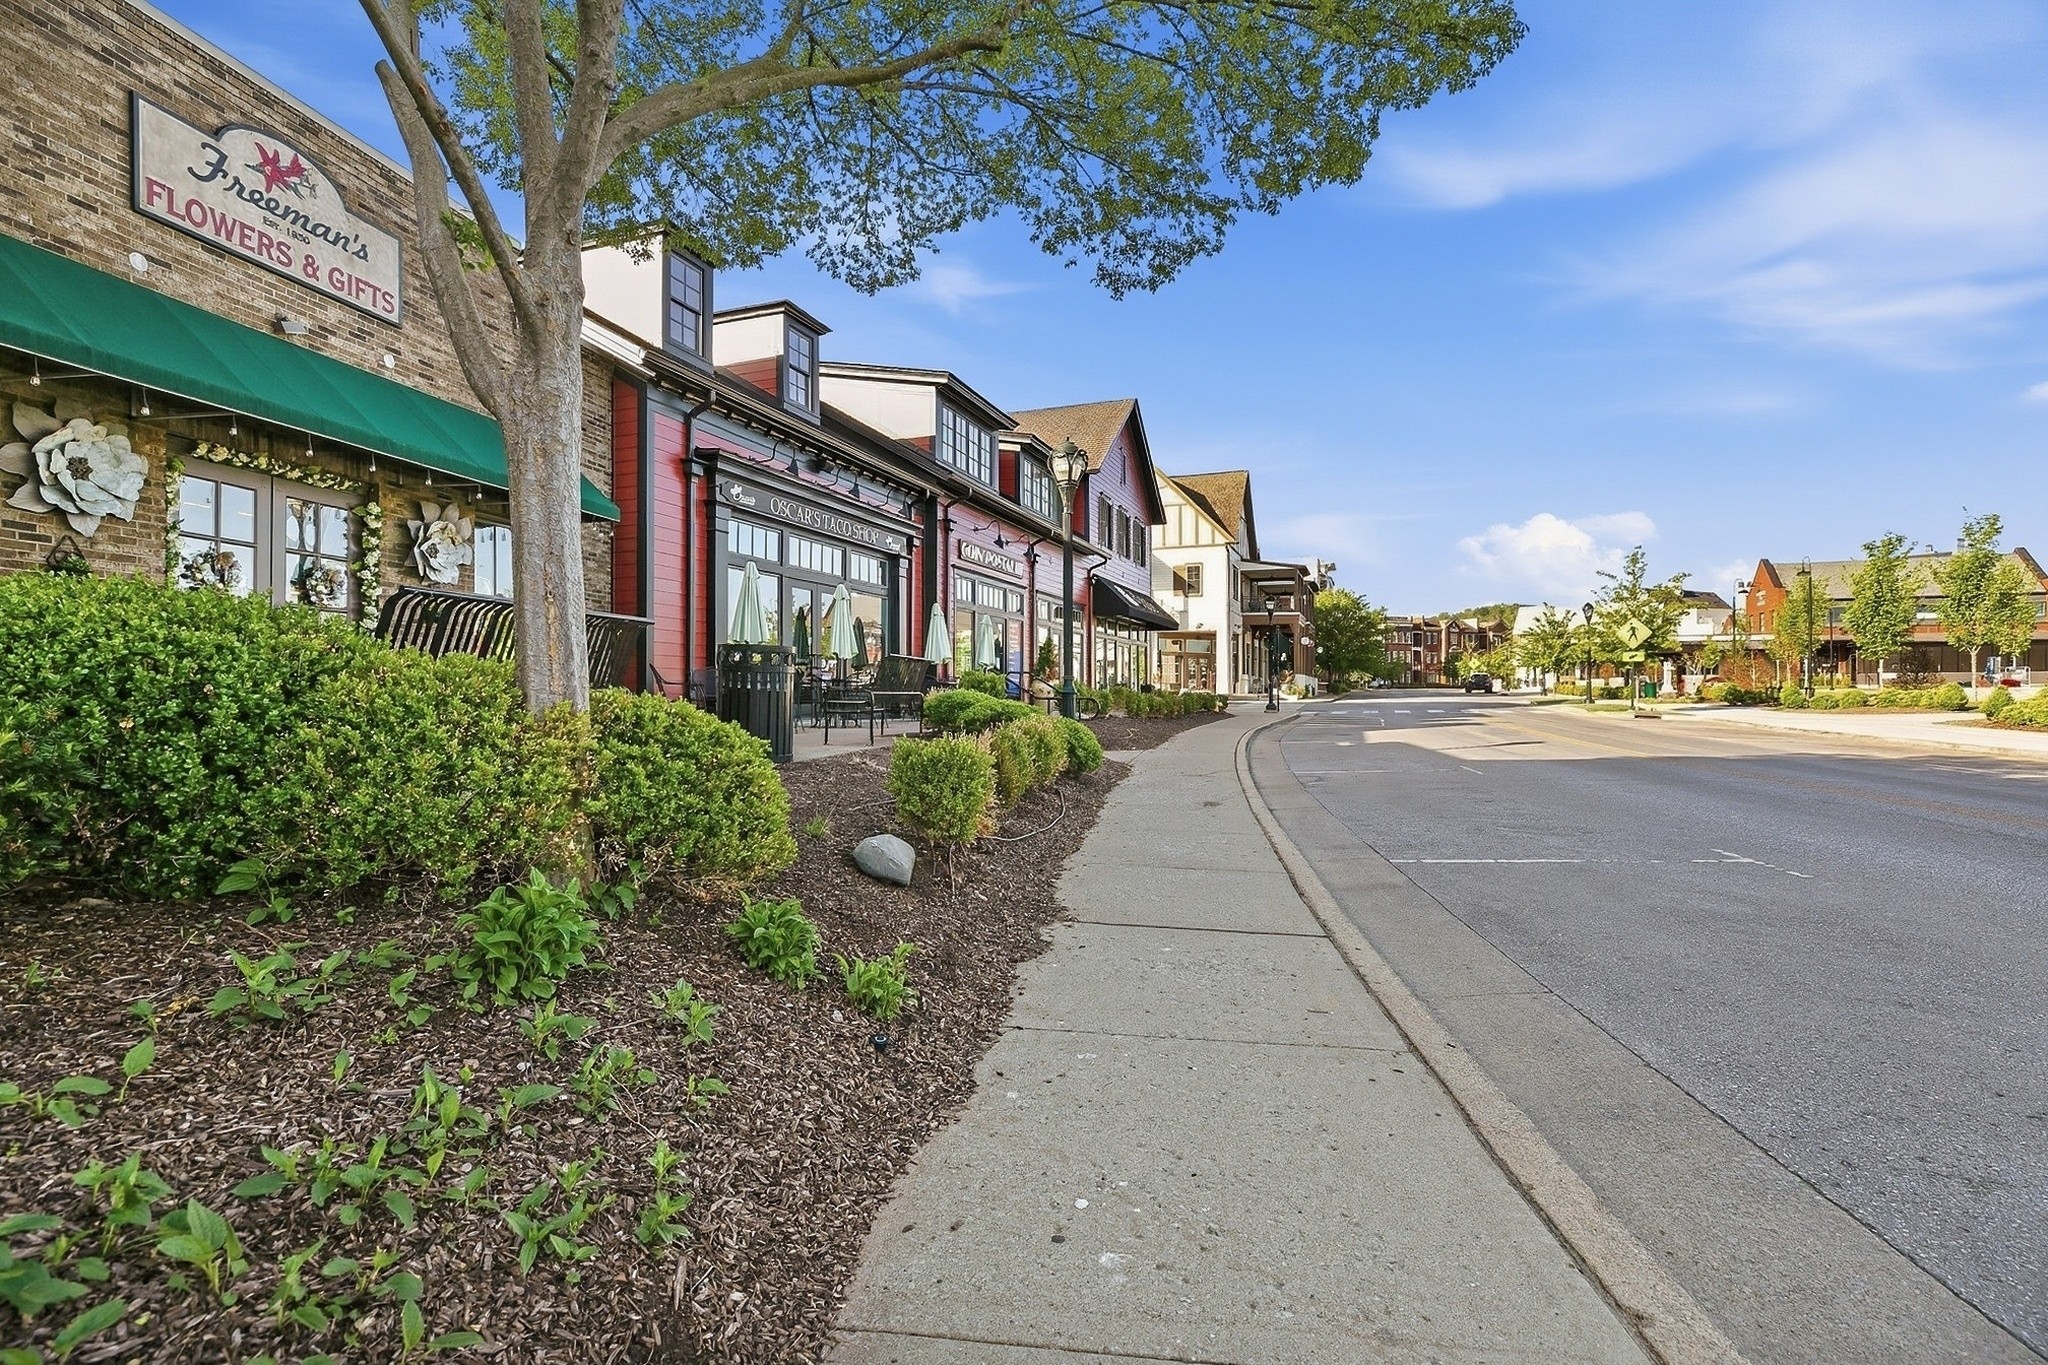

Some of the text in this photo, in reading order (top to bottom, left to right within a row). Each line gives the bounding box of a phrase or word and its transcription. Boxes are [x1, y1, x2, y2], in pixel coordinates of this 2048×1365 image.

[145, 177, 395, 315] FLOWERS & GIFTS
[187, 142, 369, 263] Freeman's
[770, 497, 821, 528] OSCAR'S
[822, 514, 851, 536] TACO
[852, 523, 879, 544] SHOP
